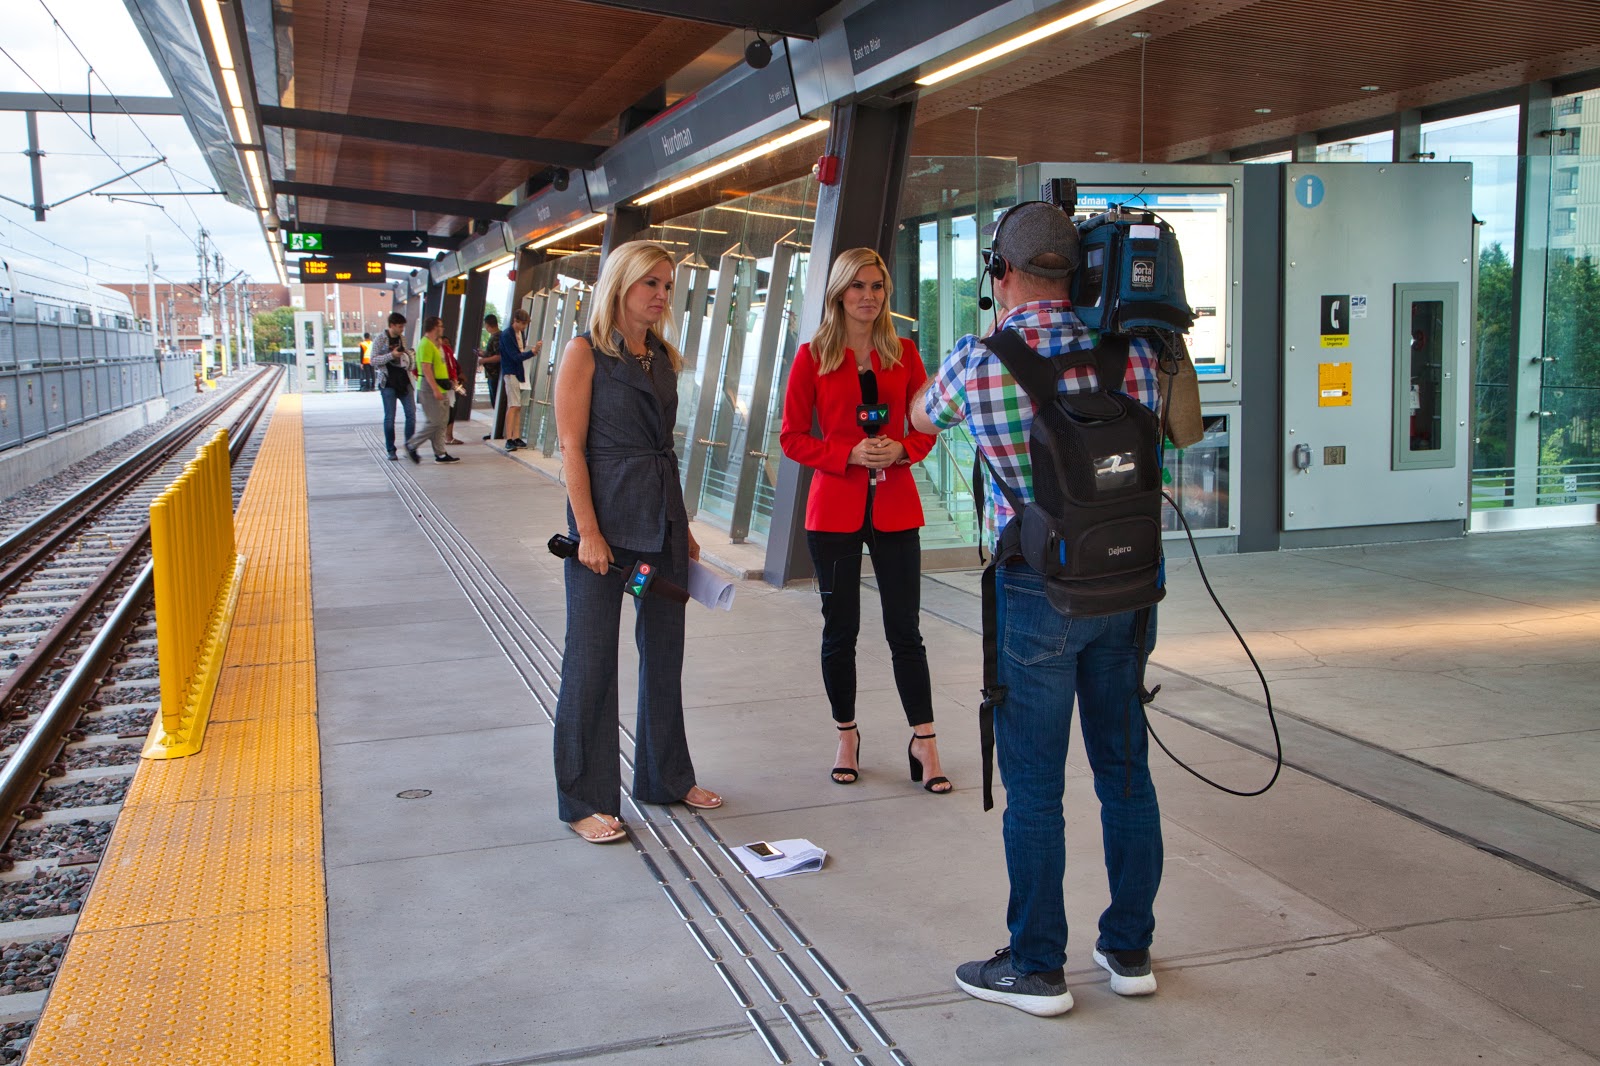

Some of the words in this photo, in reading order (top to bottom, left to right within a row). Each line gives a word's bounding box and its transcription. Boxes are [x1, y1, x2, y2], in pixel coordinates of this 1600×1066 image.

[853, 47, 864, 60] East
[864, 44, 870, 55] to
[870, 37, 881, 52] Blair
[661, 127, 693, 157] Hurdman
[1077, 196, 1107, 205] rdman
[1133, 274, 1152, 283] brace
[860, 410, 887, 421] CTV
[1108, 545, 1132, 556] Dejero
[631, 563, 651, 595] CTV
